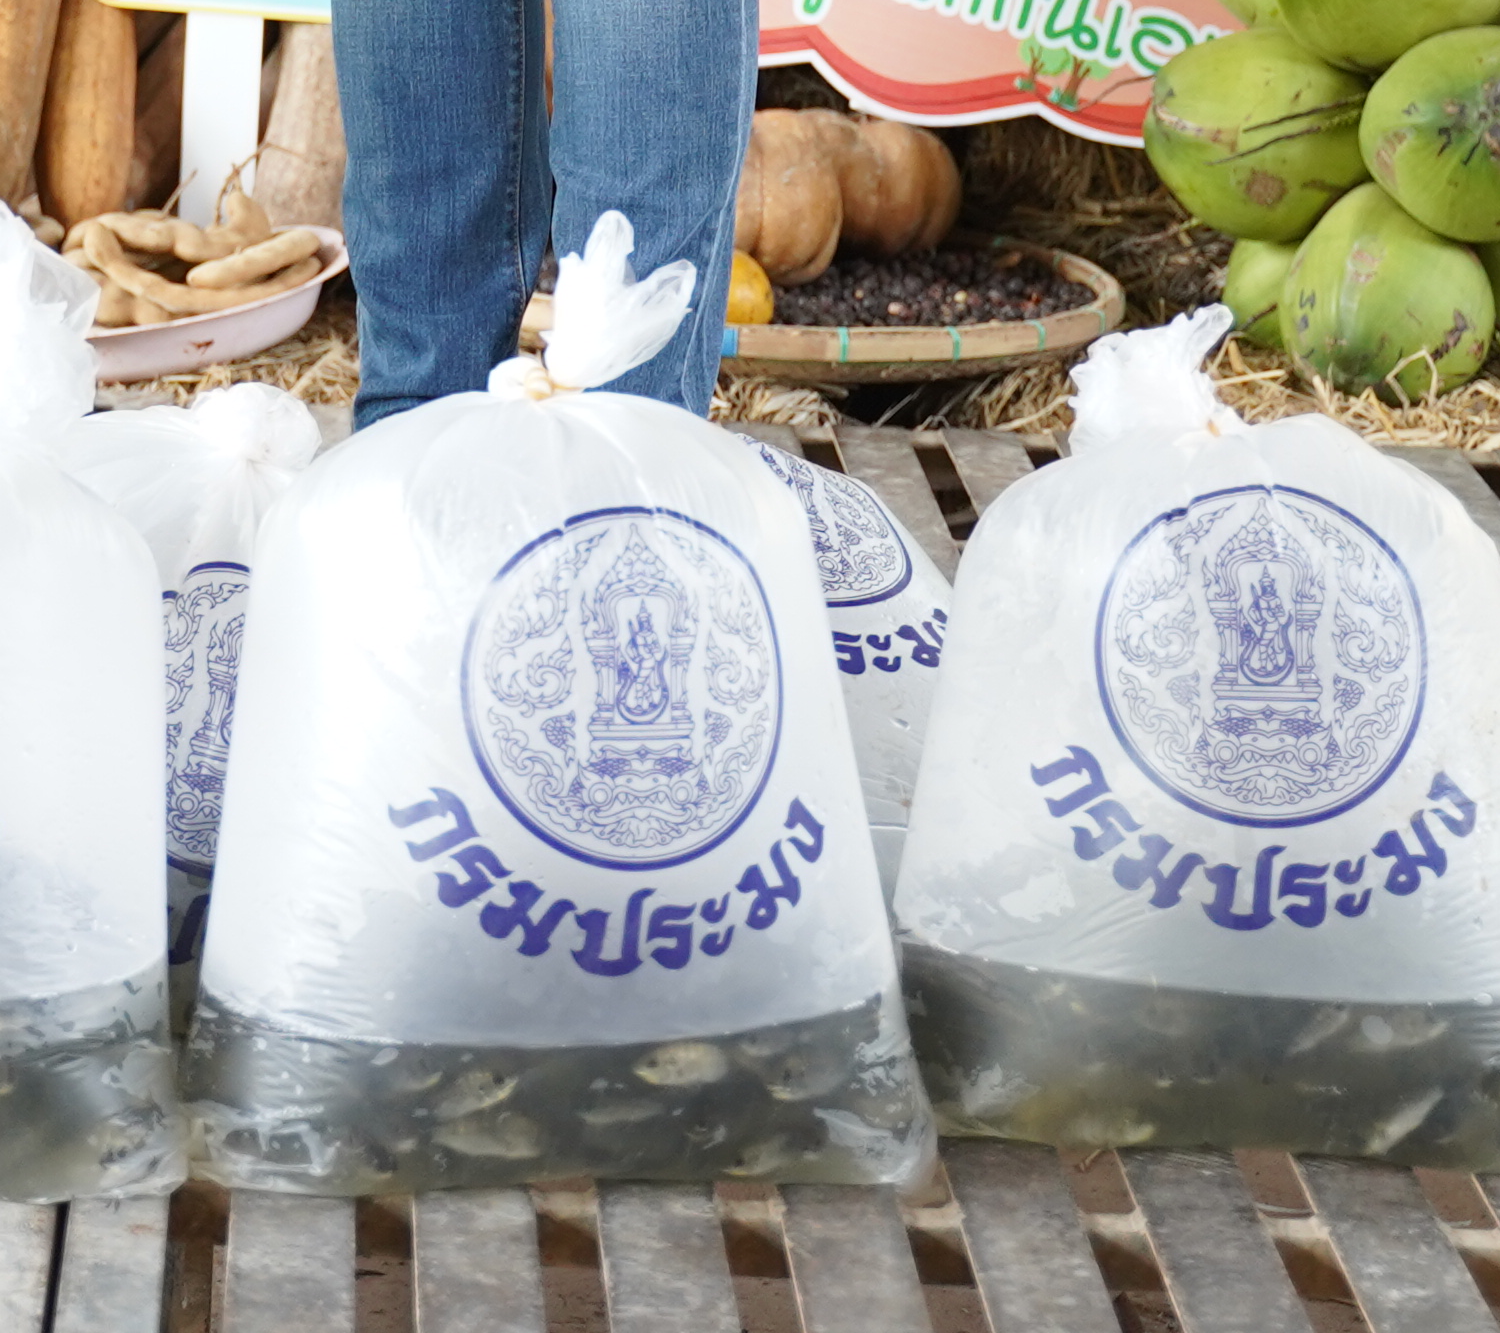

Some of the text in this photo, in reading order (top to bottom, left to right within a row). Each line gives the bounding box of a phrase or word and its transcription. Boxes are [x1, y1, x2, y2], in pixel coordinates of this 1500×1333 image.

[387, 785, 826, 978] กรมประมง
[1030, 745, 1479, 932] กรมประมง
